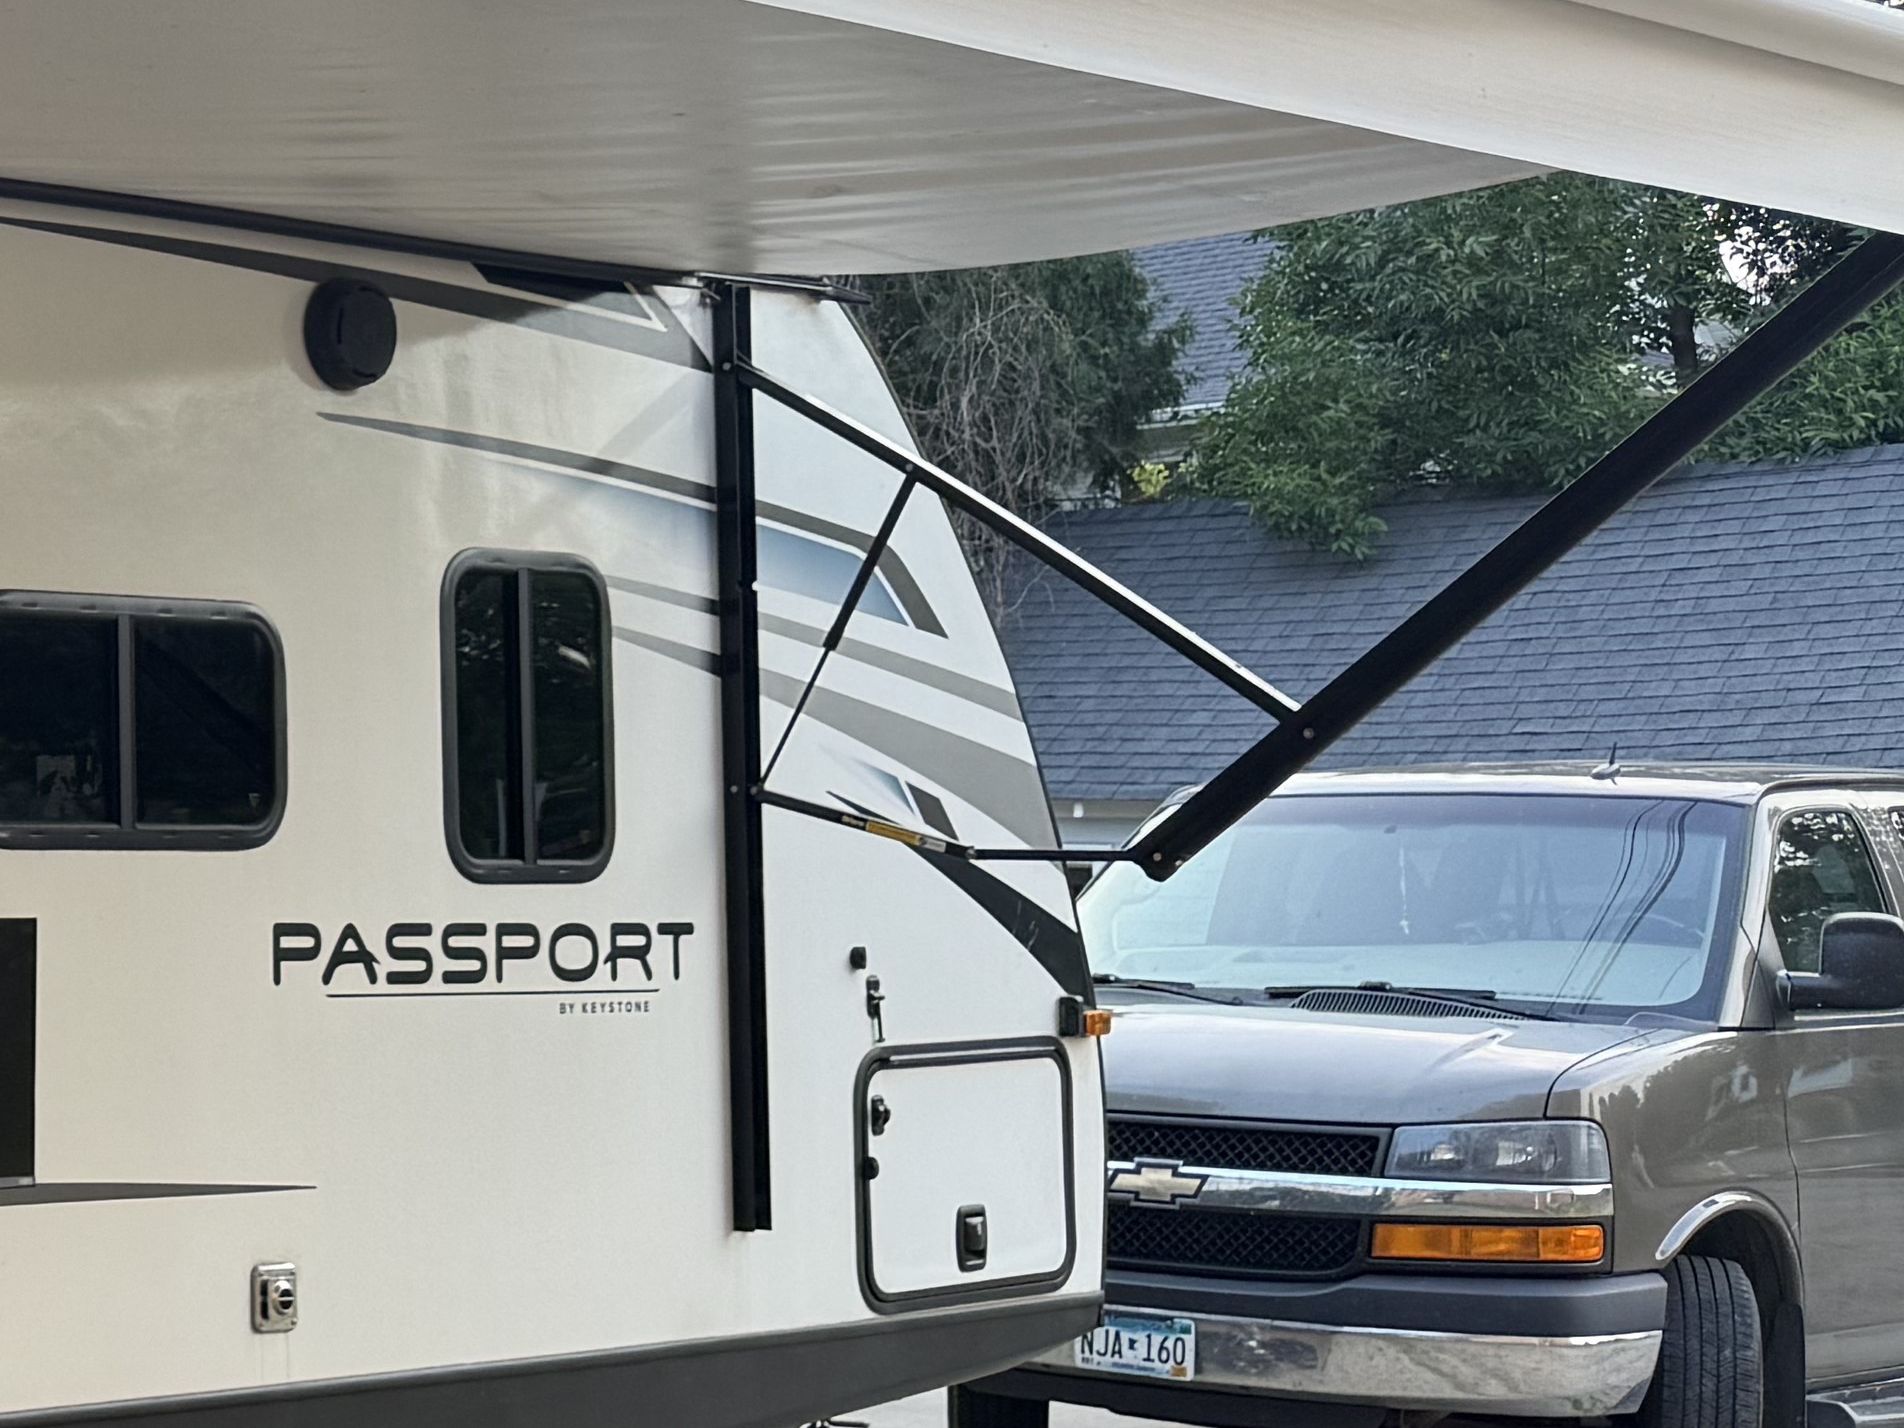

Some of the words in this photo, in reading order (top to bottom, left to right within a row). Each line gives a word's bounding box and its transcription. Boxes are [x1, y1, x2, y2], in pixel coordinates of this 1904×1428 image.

[271, 921, 695, 987] PASSPORT
[559, 1002, 575, 1014] BY
[581, 1000, 650, 1014] KEYSTONE
[1080, 1328, 1123, 1359] NJA
[1141, 1333, 1186, 1366] 160
